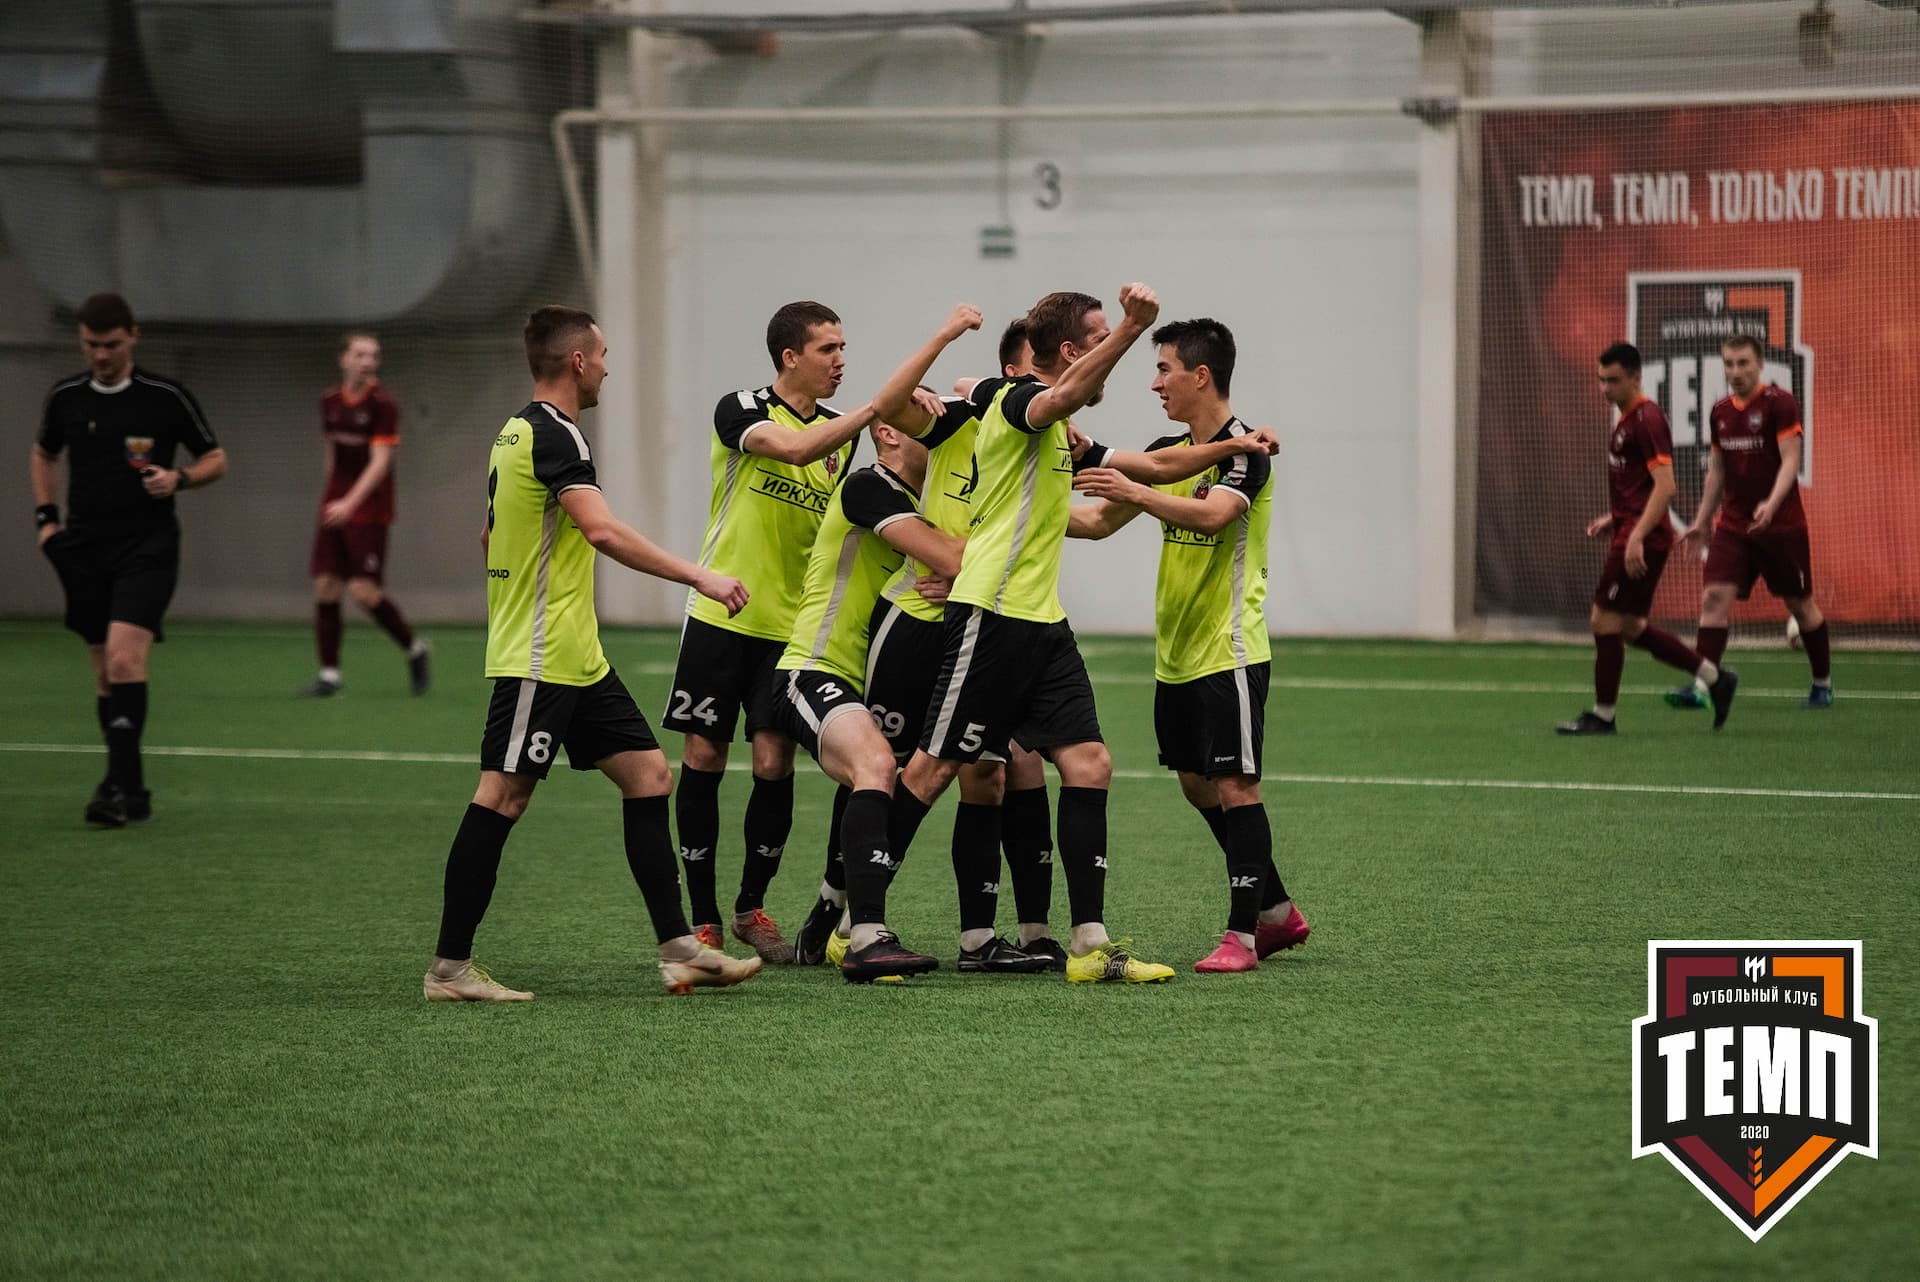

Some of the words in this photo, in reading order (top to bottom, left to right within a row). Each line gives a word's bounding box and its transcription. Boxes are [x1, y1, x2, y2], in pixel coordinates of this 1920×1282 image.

[1035, 162, 1061, 211] 3
[1519, 174, 1602, 231] ТЕМП,
[1612, 171, 1698, 229] ТЕМП,
[1708, 168, 1823, 223] ТОЛЬКО
[671, 689, 718, 726] 24
[816, 682, 843, 701] 3
[871, 704, 905, 738] 69
[958, 721, 986, 752] 5
[527, 731, 553, 763] 8
